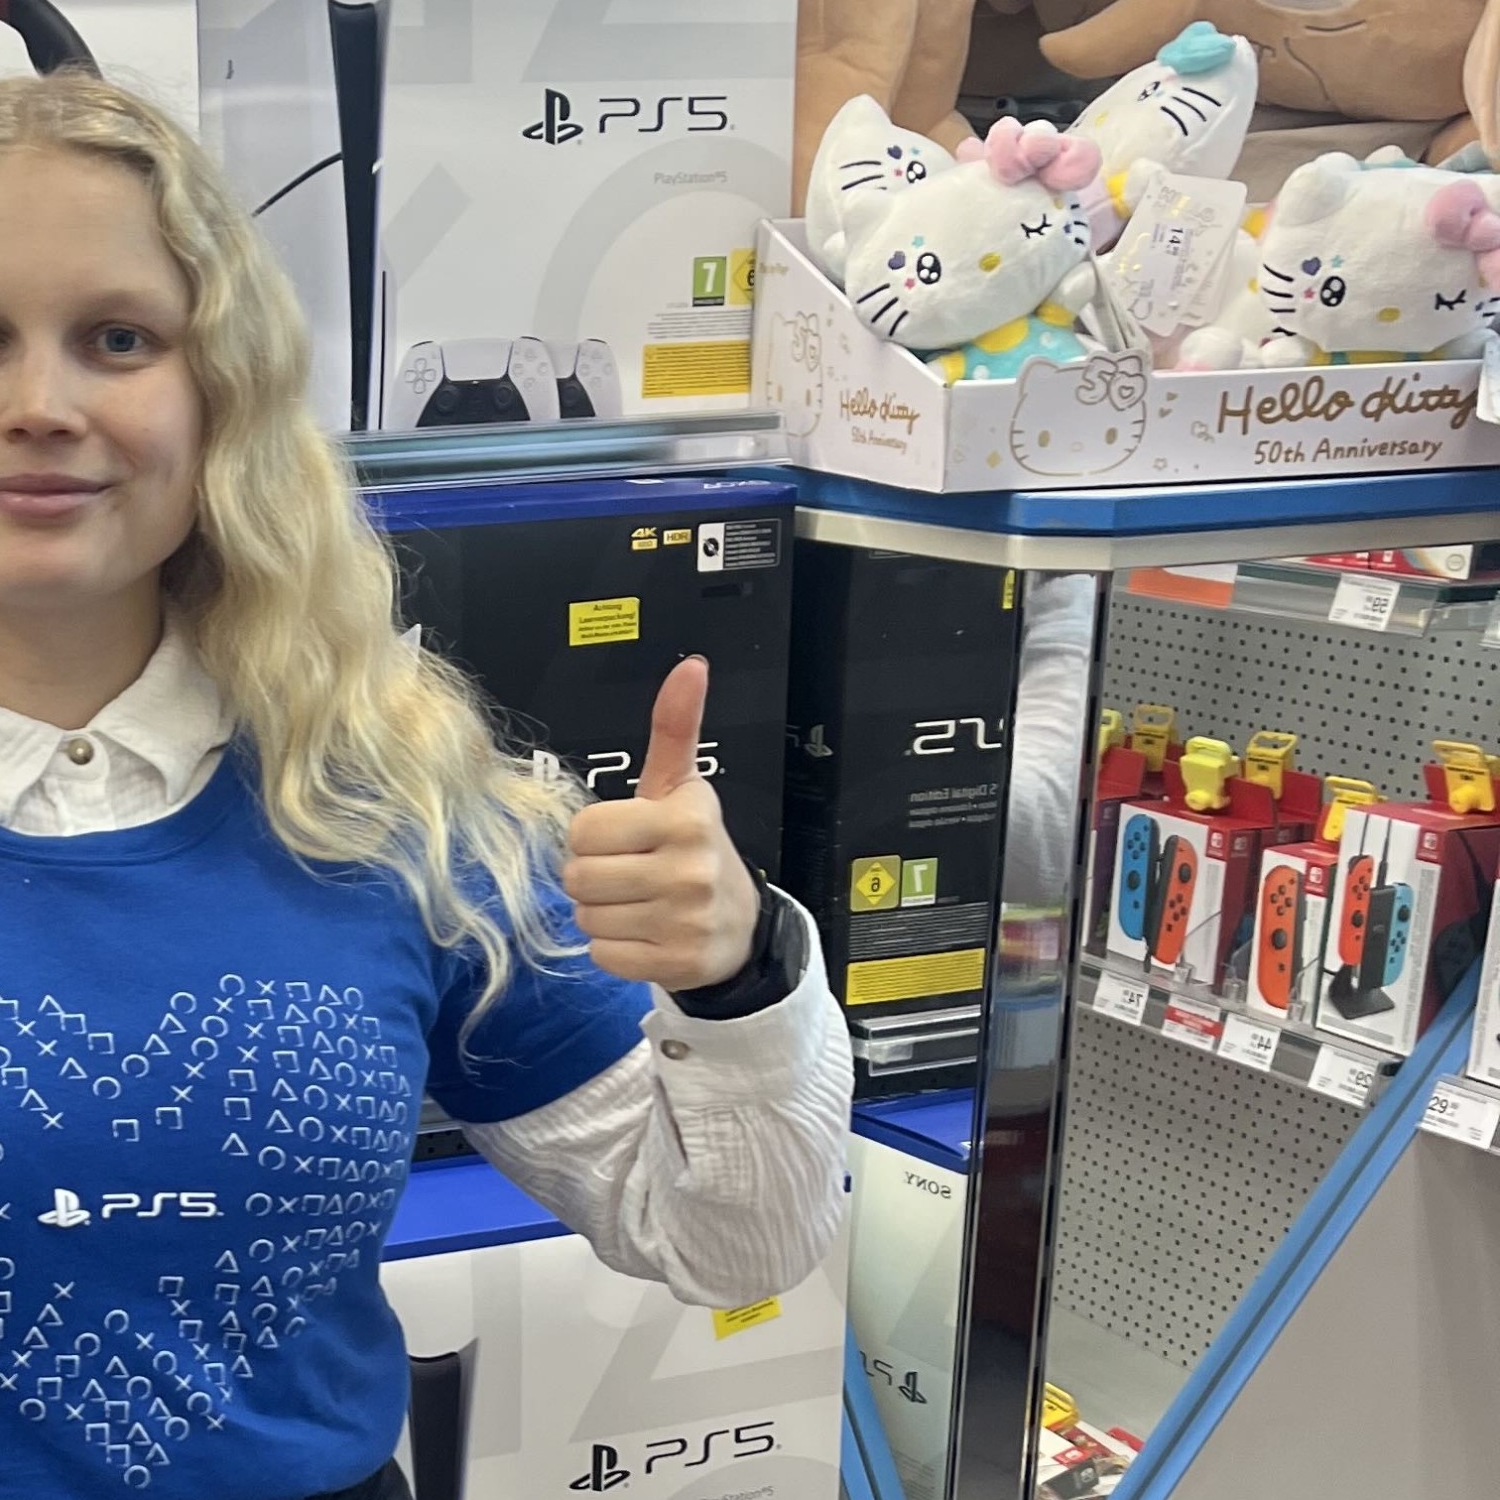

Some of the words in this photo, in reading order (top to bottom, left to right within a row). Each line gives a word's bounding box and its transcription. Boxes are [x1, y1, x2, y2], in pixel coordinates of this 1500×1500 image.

[599, 97, 728, 133] PS5
[702, 262, 717, 293] 7
[840, 387, 878, 421] Hello
[1217, 375, 1355, 435] Hello
[1361, 373, 1478, 429] Kitty
[1254, 440, 1304, 465] 50th
[1312, 437, 1443, 462] Anniversary
[630, 527, 659, 538] 4K
[666, 531, 689, 542] HDR
[1428, 1096, 1448, 1113] 29
[101, 1193, 217, 1217] PS5
[645, 1421, 775, 1474] PS5
